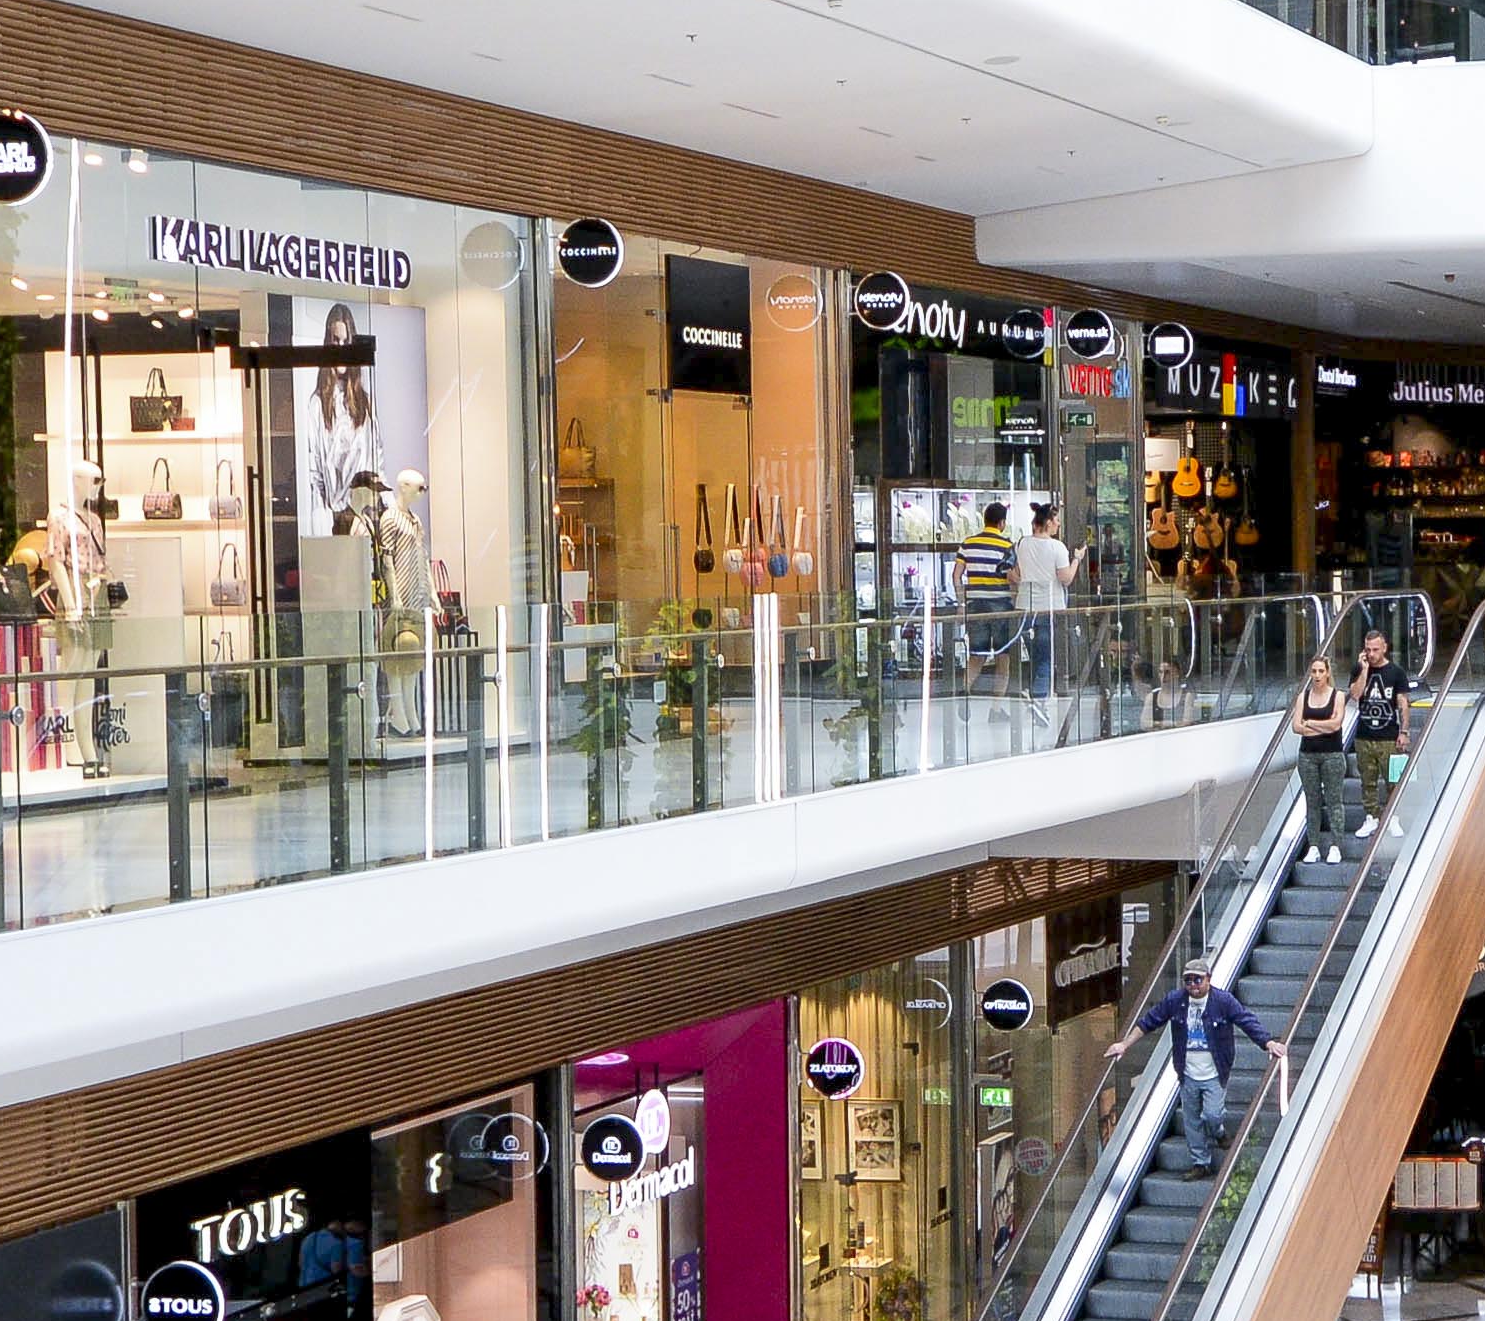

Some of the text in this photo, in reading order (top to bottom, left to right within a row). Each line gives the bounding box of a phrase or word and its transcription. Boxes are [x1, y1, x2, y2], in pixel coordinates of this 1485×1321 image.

[147, 214, 412, 290] KARL LAGERFELD
[683, 326, 743, 349] COCCINELLE
[1393, 380, 1453, 403] Julius
[609, 1145, 695, 1216] Dermacol
[190, 1188, 307, 1264] TOUS
